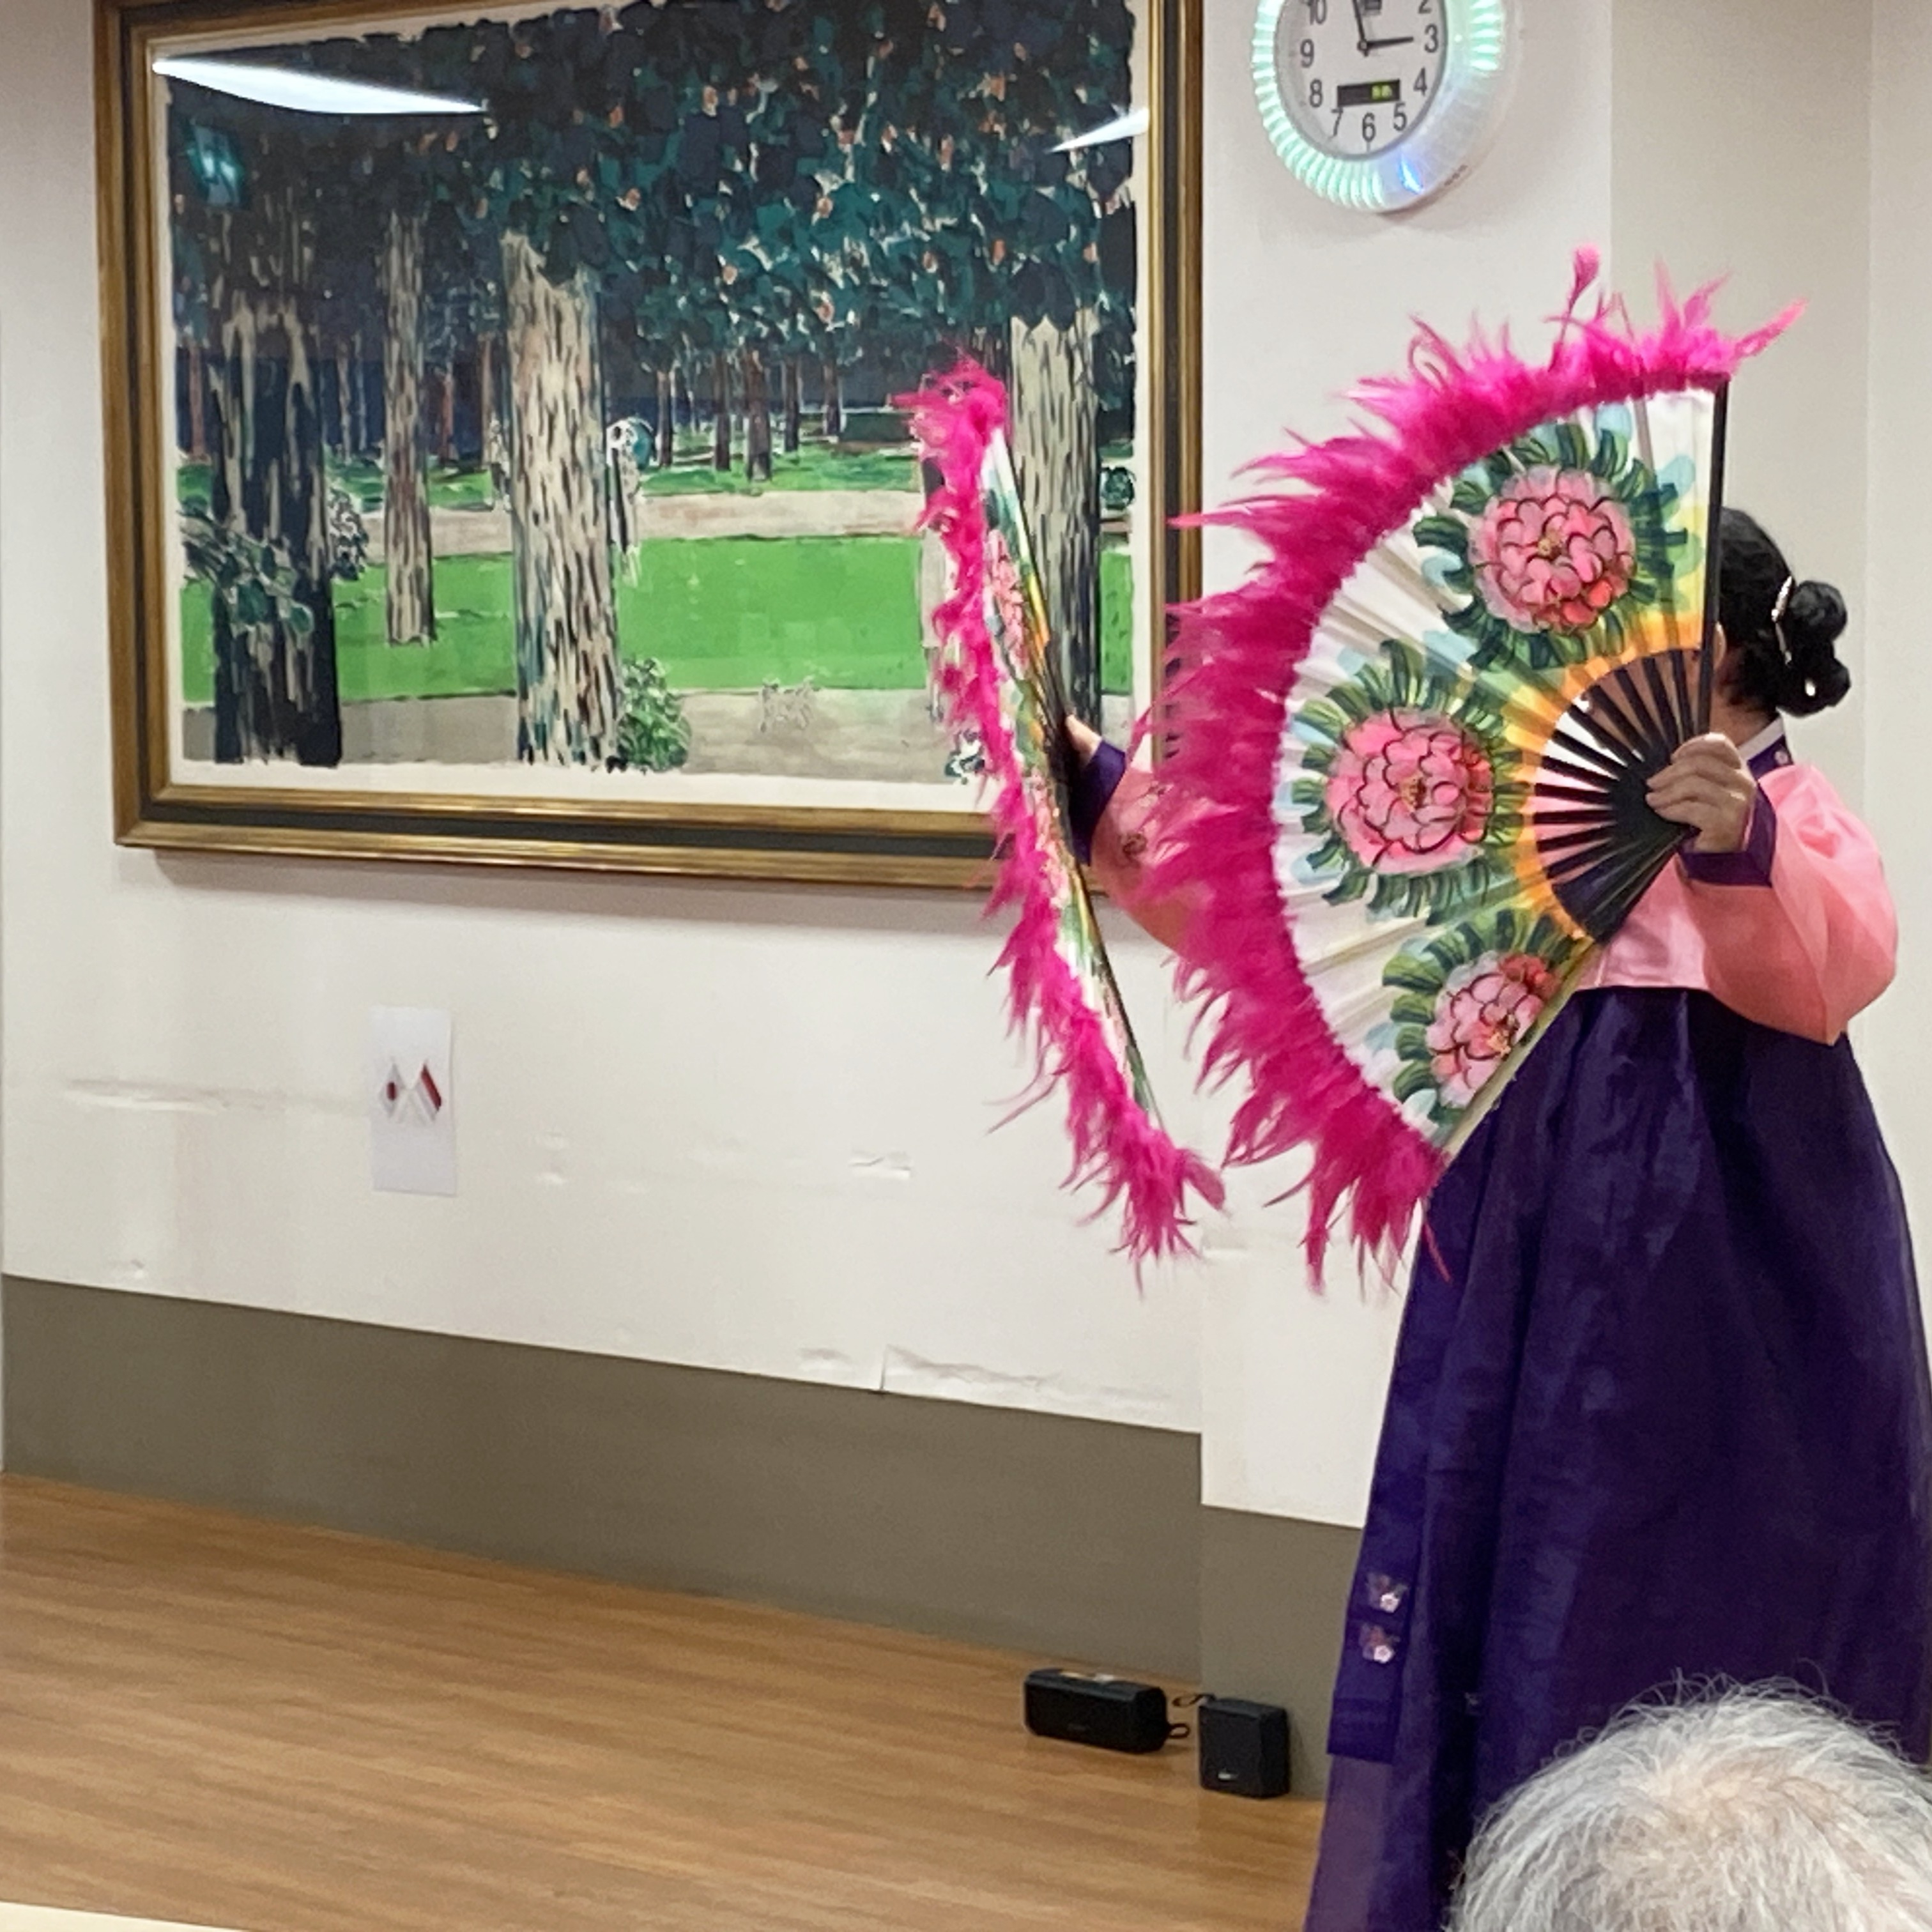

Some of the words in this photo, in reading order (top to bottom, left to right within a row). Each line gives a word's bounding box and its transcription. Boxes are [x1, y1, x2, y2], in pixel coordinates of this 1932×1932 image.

[1307, 0, 1326, 25] 10
[1425, 24, 1438, 53] 3
[1301, 39, 1314, 68] 9
[1309, 79, 1322, 107] 8
[1413, 68, 1427, 96] 4
[1331, 109, 1344, 137] 7
[1362, 113, 1376, 142] 6
[1393, 103, 1407, 130] 5
